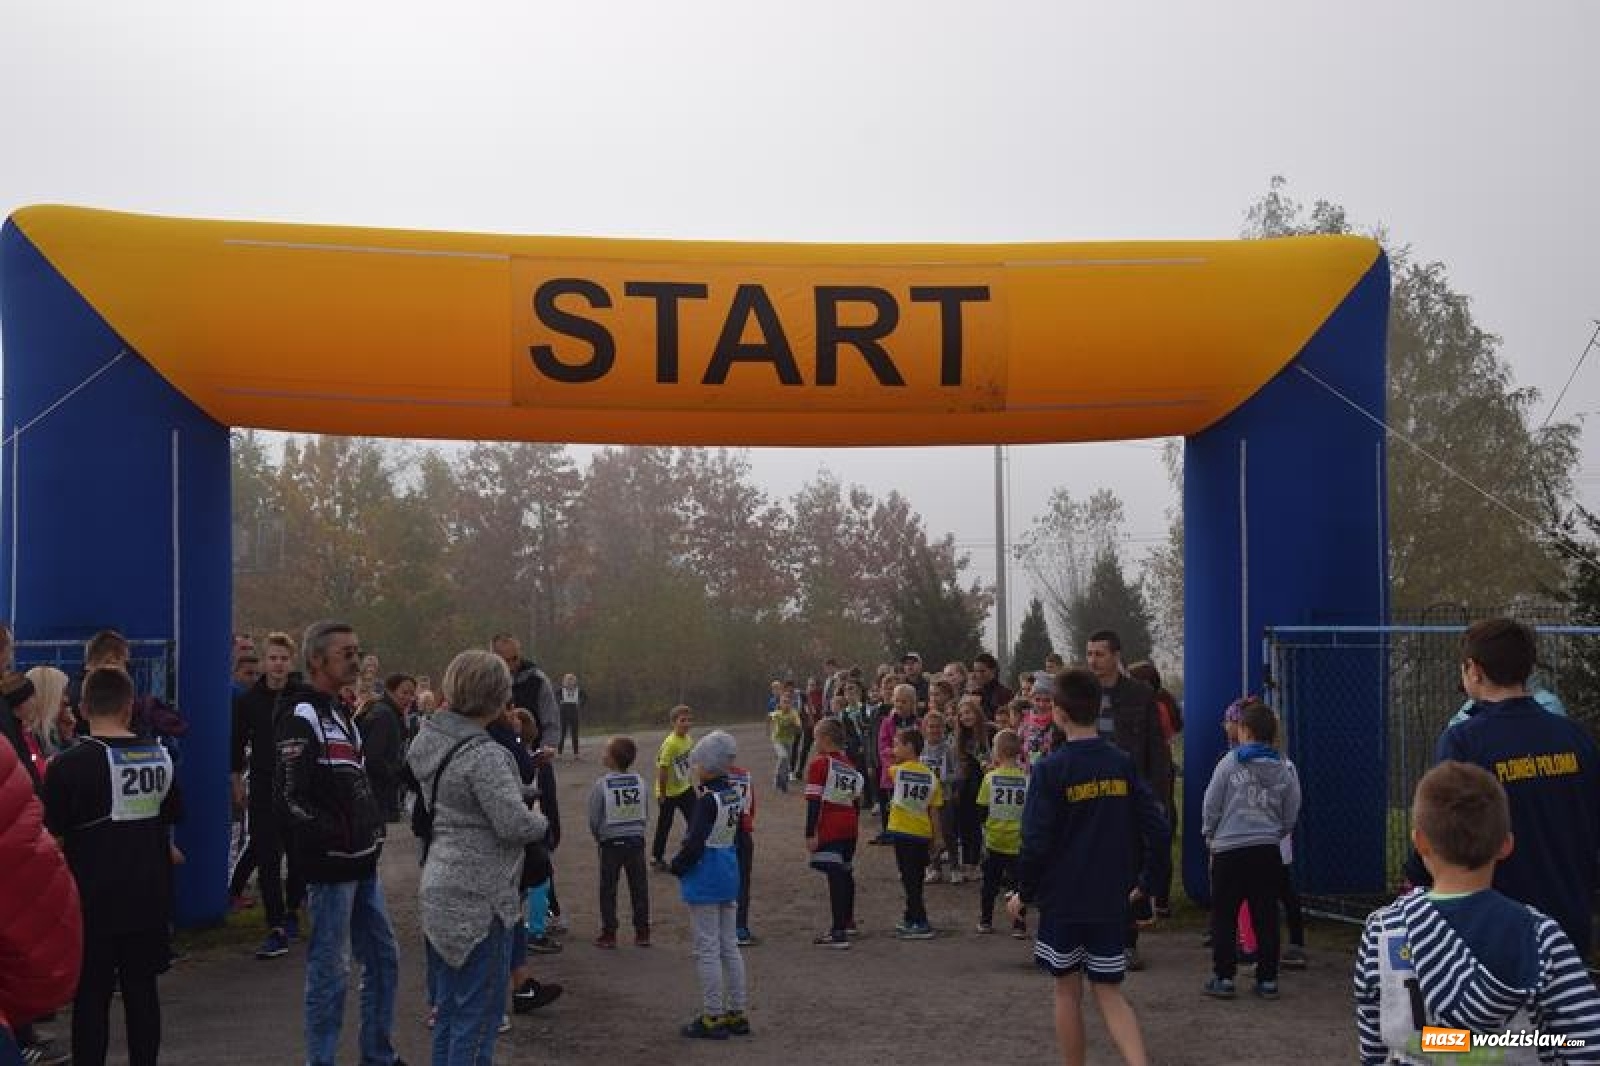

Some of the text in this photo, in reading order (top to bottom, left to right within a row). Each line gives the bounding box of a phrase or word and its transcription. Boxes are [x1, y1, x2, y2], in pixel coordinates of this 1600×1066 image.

[529, 278, 990, 386] START
[122, 767, 167, 796] 200
[613, 788, 641, 808] 152
